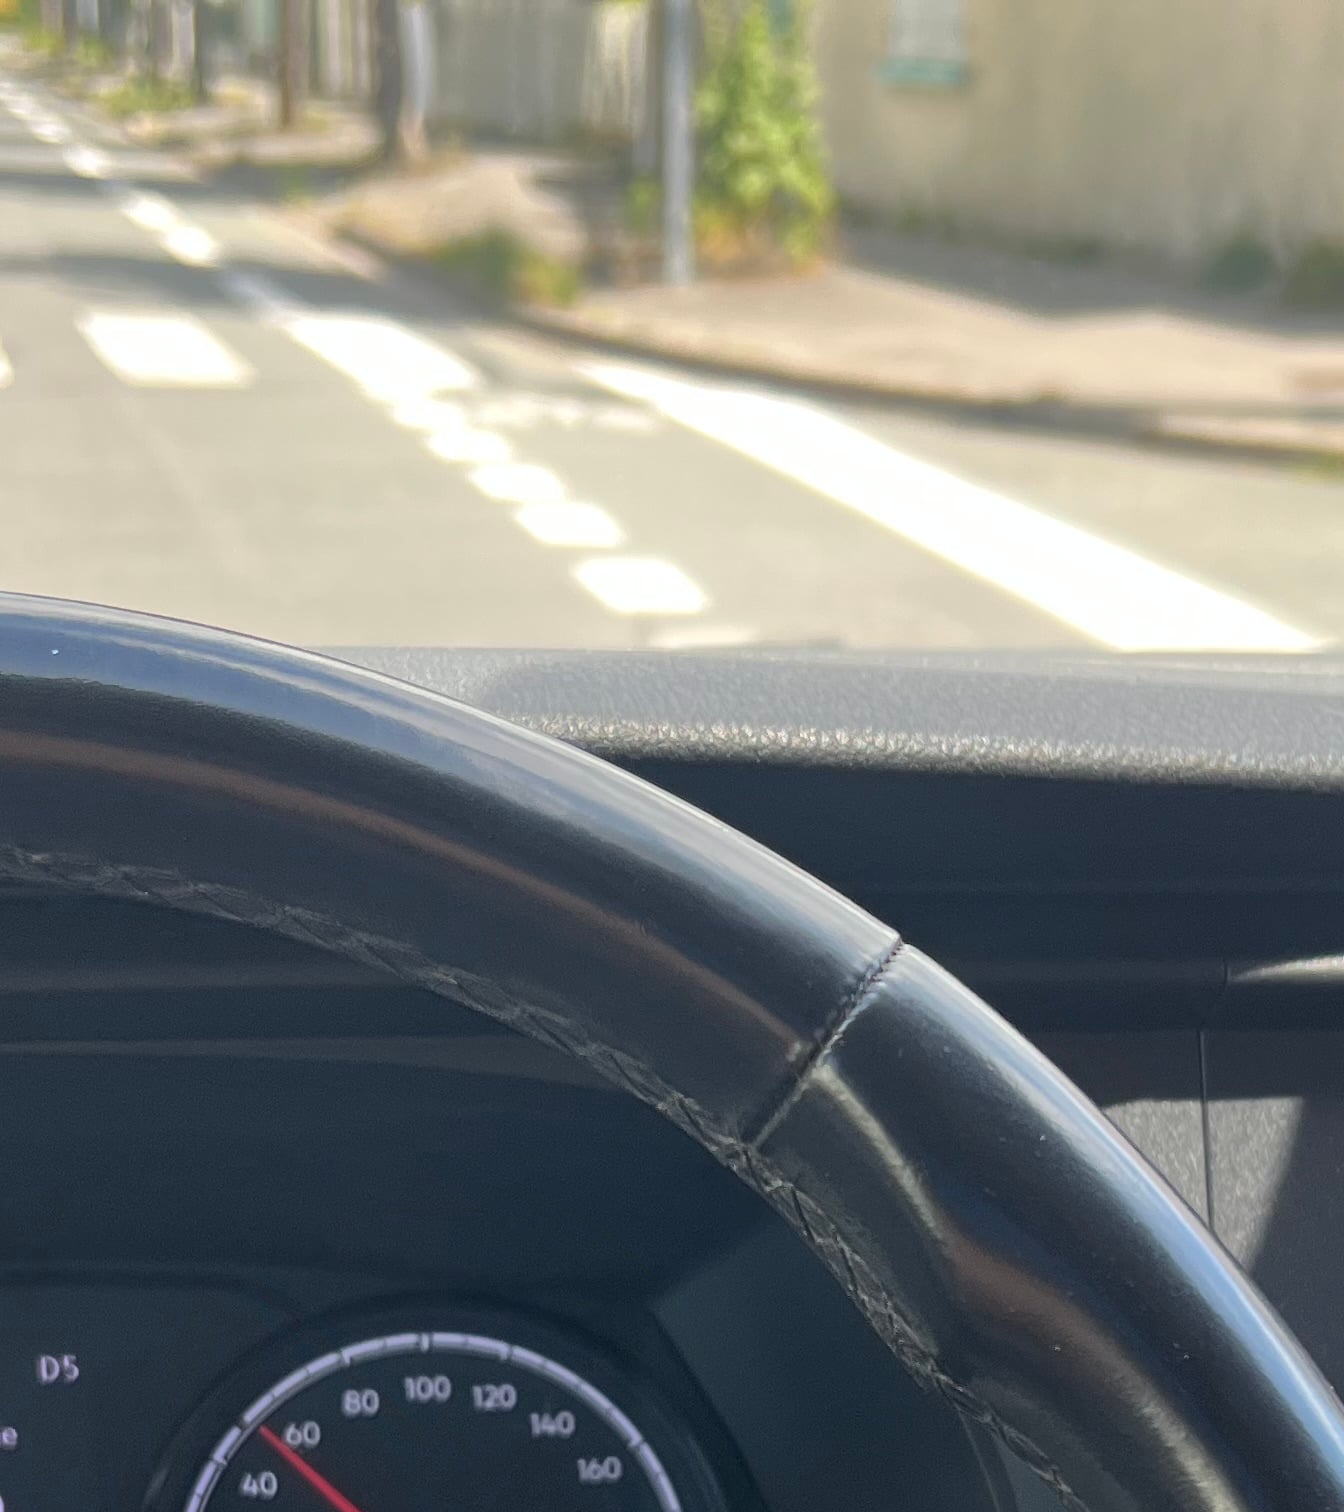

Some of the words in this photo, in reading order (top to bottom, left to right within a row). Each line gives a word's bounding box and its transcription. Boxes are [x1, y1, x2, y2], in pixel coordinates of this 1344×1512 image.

[404, 1376, 452, 1401] 100
[472, 1384, 518, 1410] 120
[342, 1389, 380, 1416] 80
[284, 1421, 322, 1447] 60
[530, 1411, 575, 1437] 140
[577, 1456, 622, 1482] 160
[240, 1471, 279, 1497] 40
